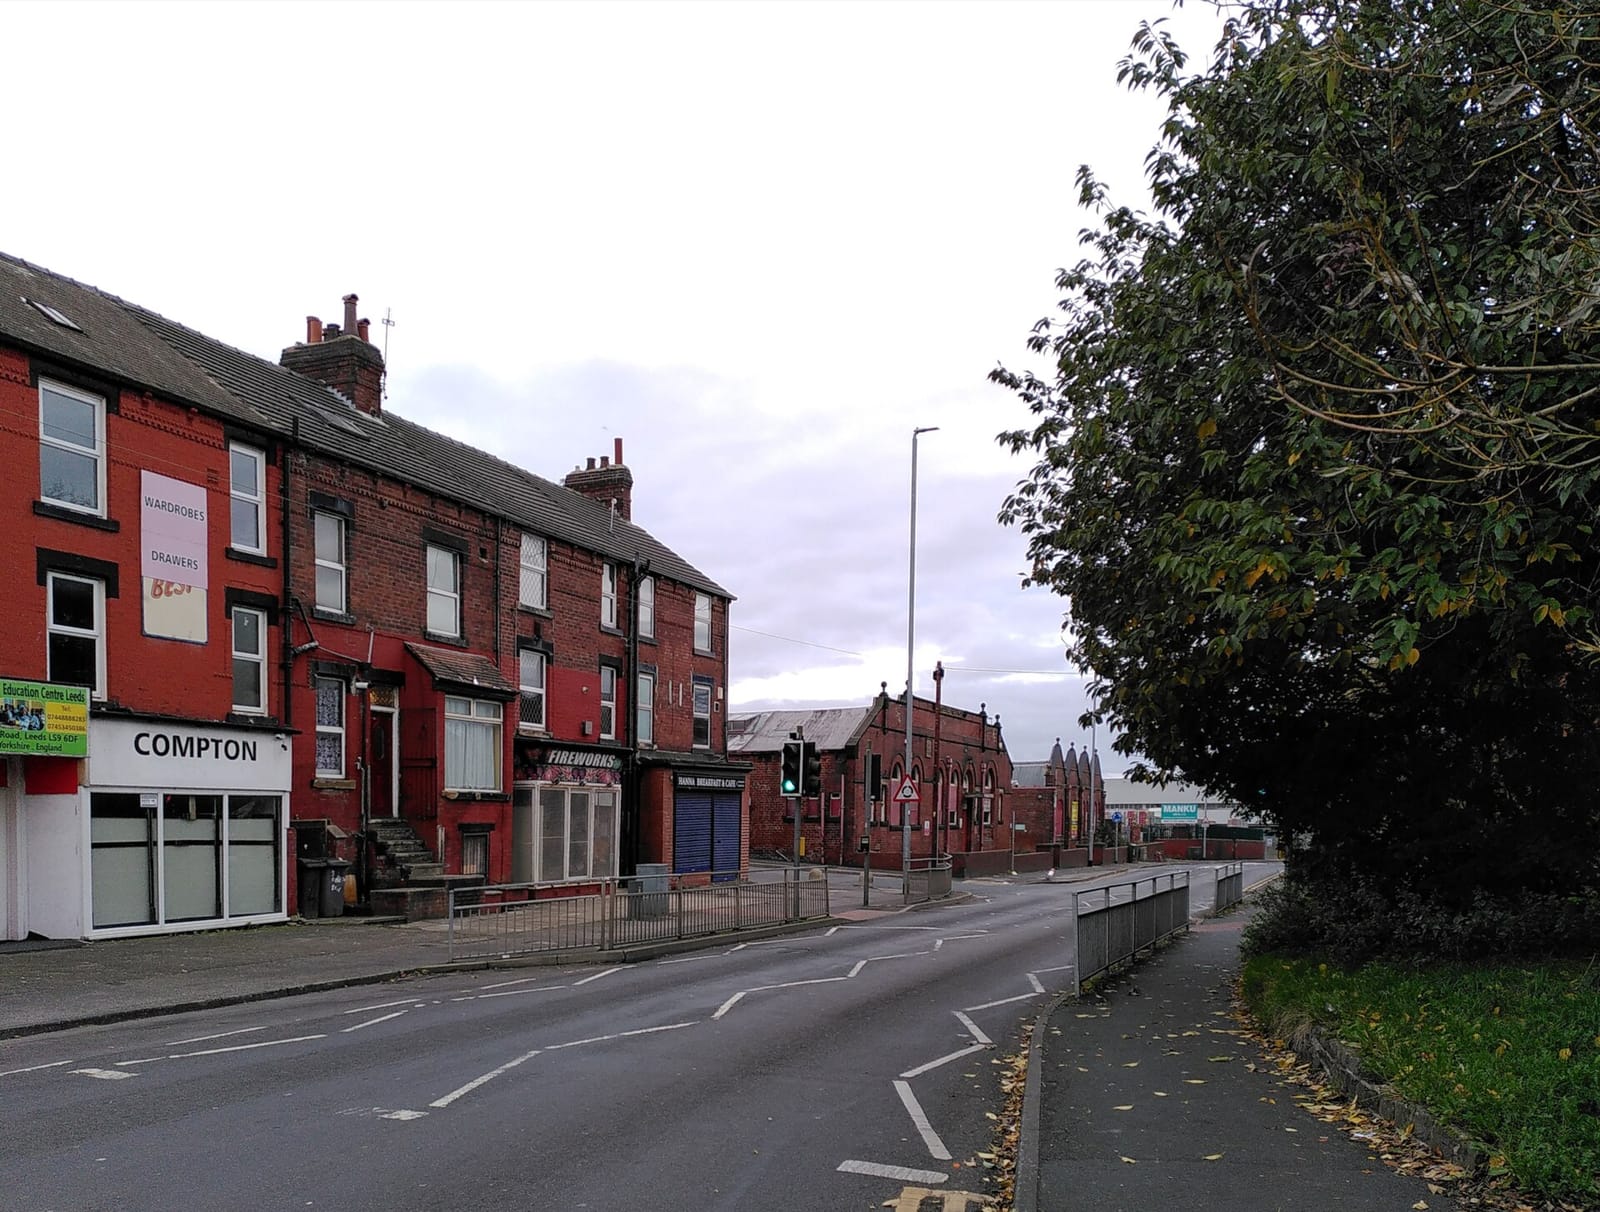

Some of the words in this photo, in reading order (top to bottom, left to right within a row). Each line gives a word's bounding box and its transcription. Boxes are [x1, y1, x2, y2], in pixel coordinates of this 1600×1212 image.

[144, 496, 205, 521] WARDROBES
[151, 551, 199, 570] DRAWERS
[3, 683, 39, 698] Education
[41, 687, 65, 700] Centre
[66, 690, 85, 702] Leeds
[25, 732, 46, 741] Leeds
[49, 734, 61, 742] LS9
[64, 735, 79, 743] 6DF
[134, 732, 257, 761] COMPTON
[36, 742, 62, 752] England
[548, 750, 615, 768] FIREWORKS
[1163, 804, 1196, 813] MANKU
